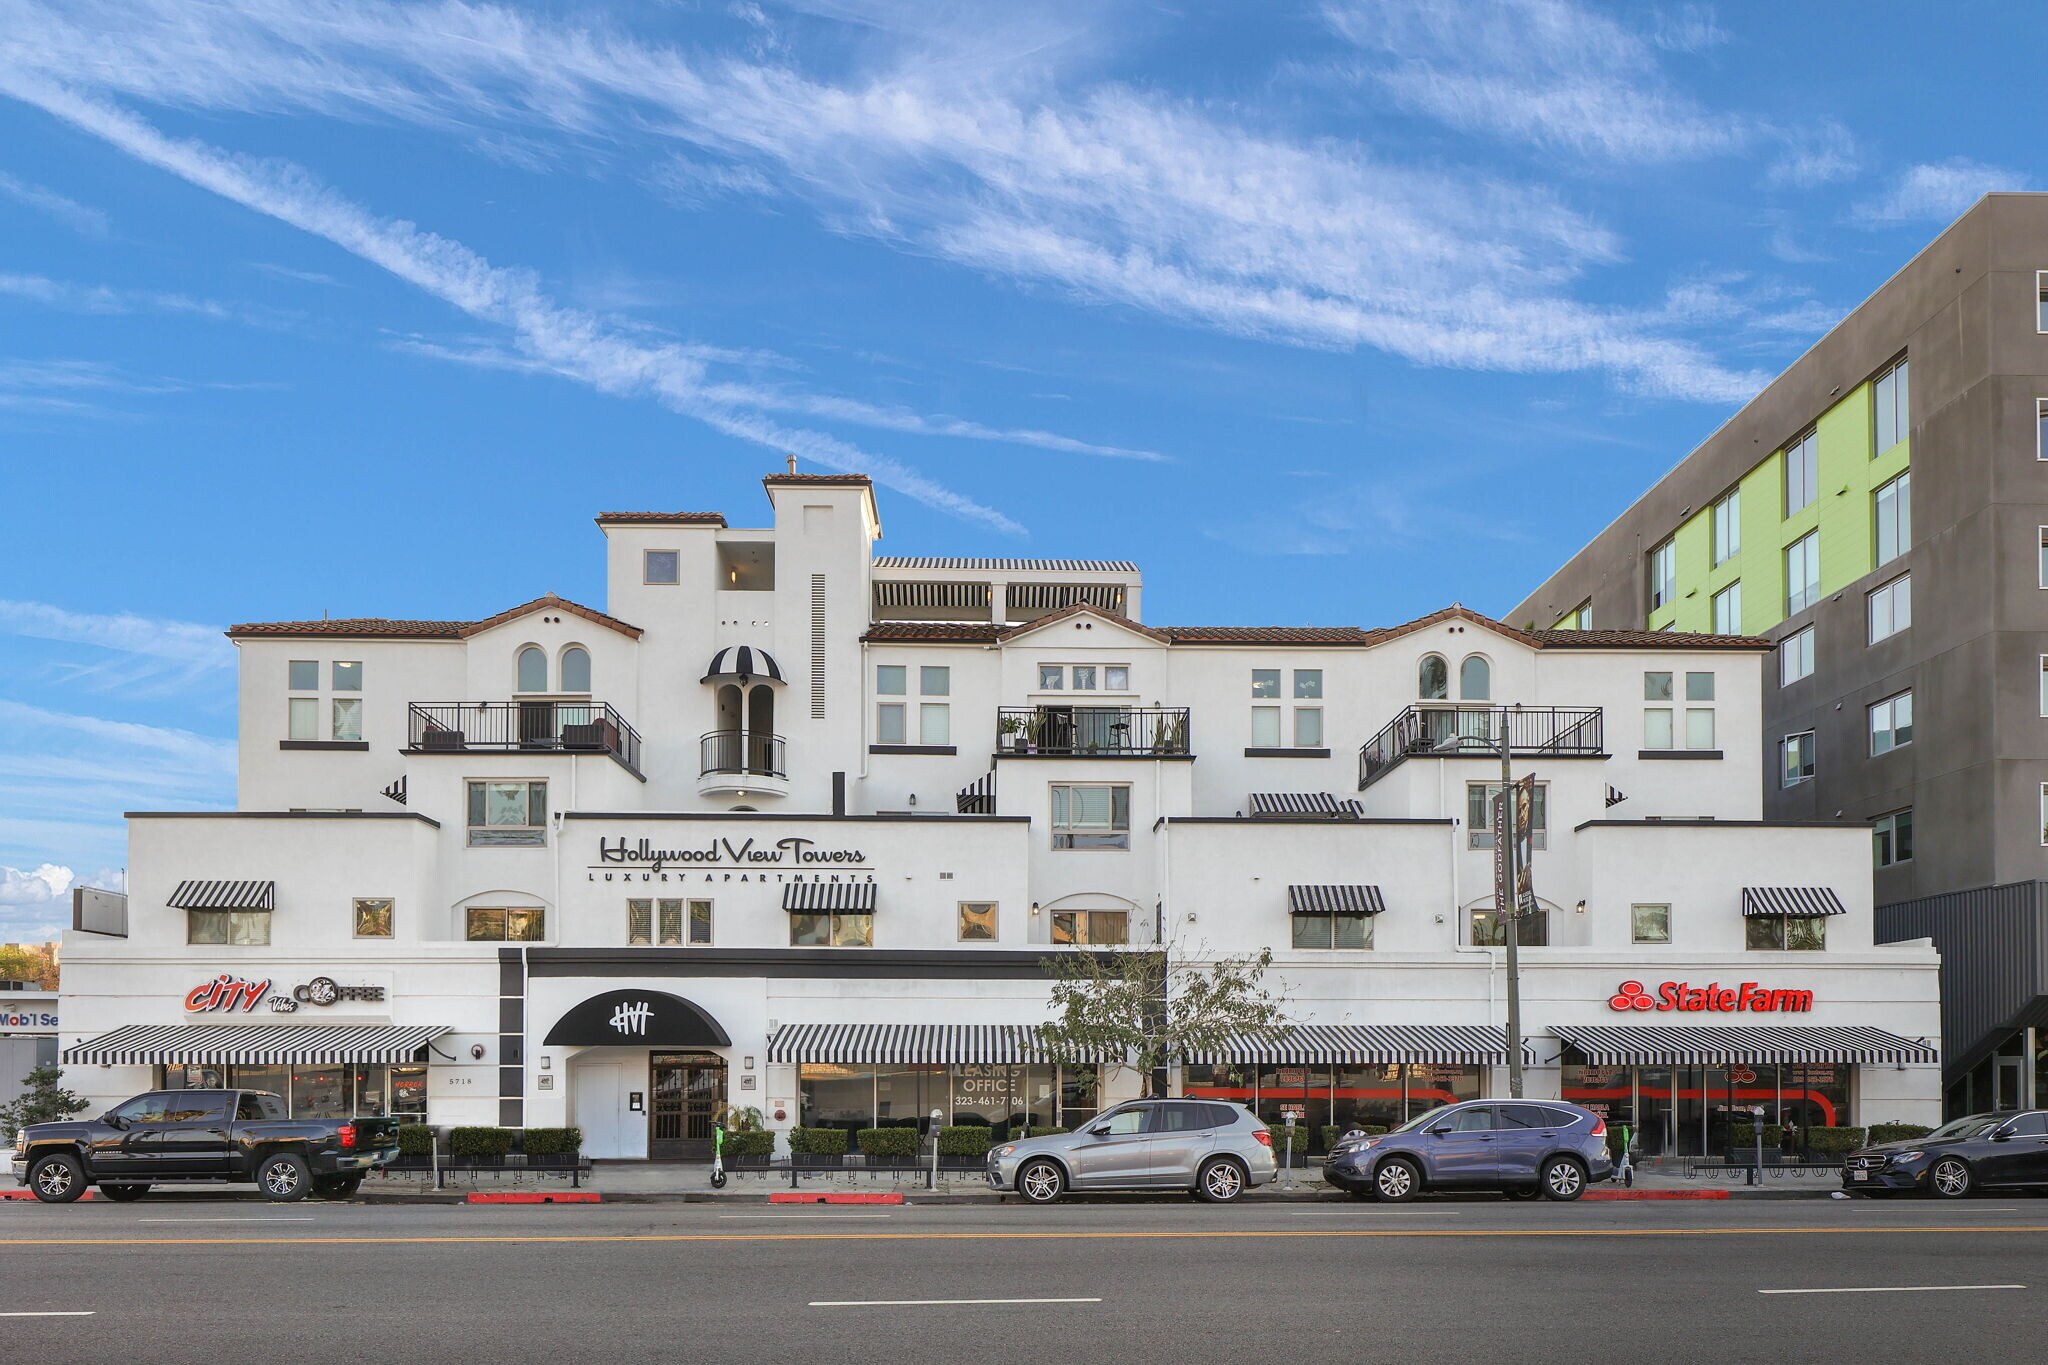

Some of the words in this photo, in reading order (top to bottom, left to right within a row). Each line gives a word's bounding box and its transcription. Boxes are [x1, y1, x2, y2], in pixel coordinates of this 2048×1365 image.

[600, 836, 722, 873] Hollywood
[722, 837, 782, 864] View
[776, 837, 866, 864] Towers
[588, 873, 686, 883] LUXURY
[704, 873, 874, 884] APARTMENTS
[269, 996, 298, 1012] Vibes
[959, 1063, 1021, 1077] LEASING
[963, 1079, 1016, 1092] OFFICE
[955, 1096, 1023, 1105] 323-461-706
